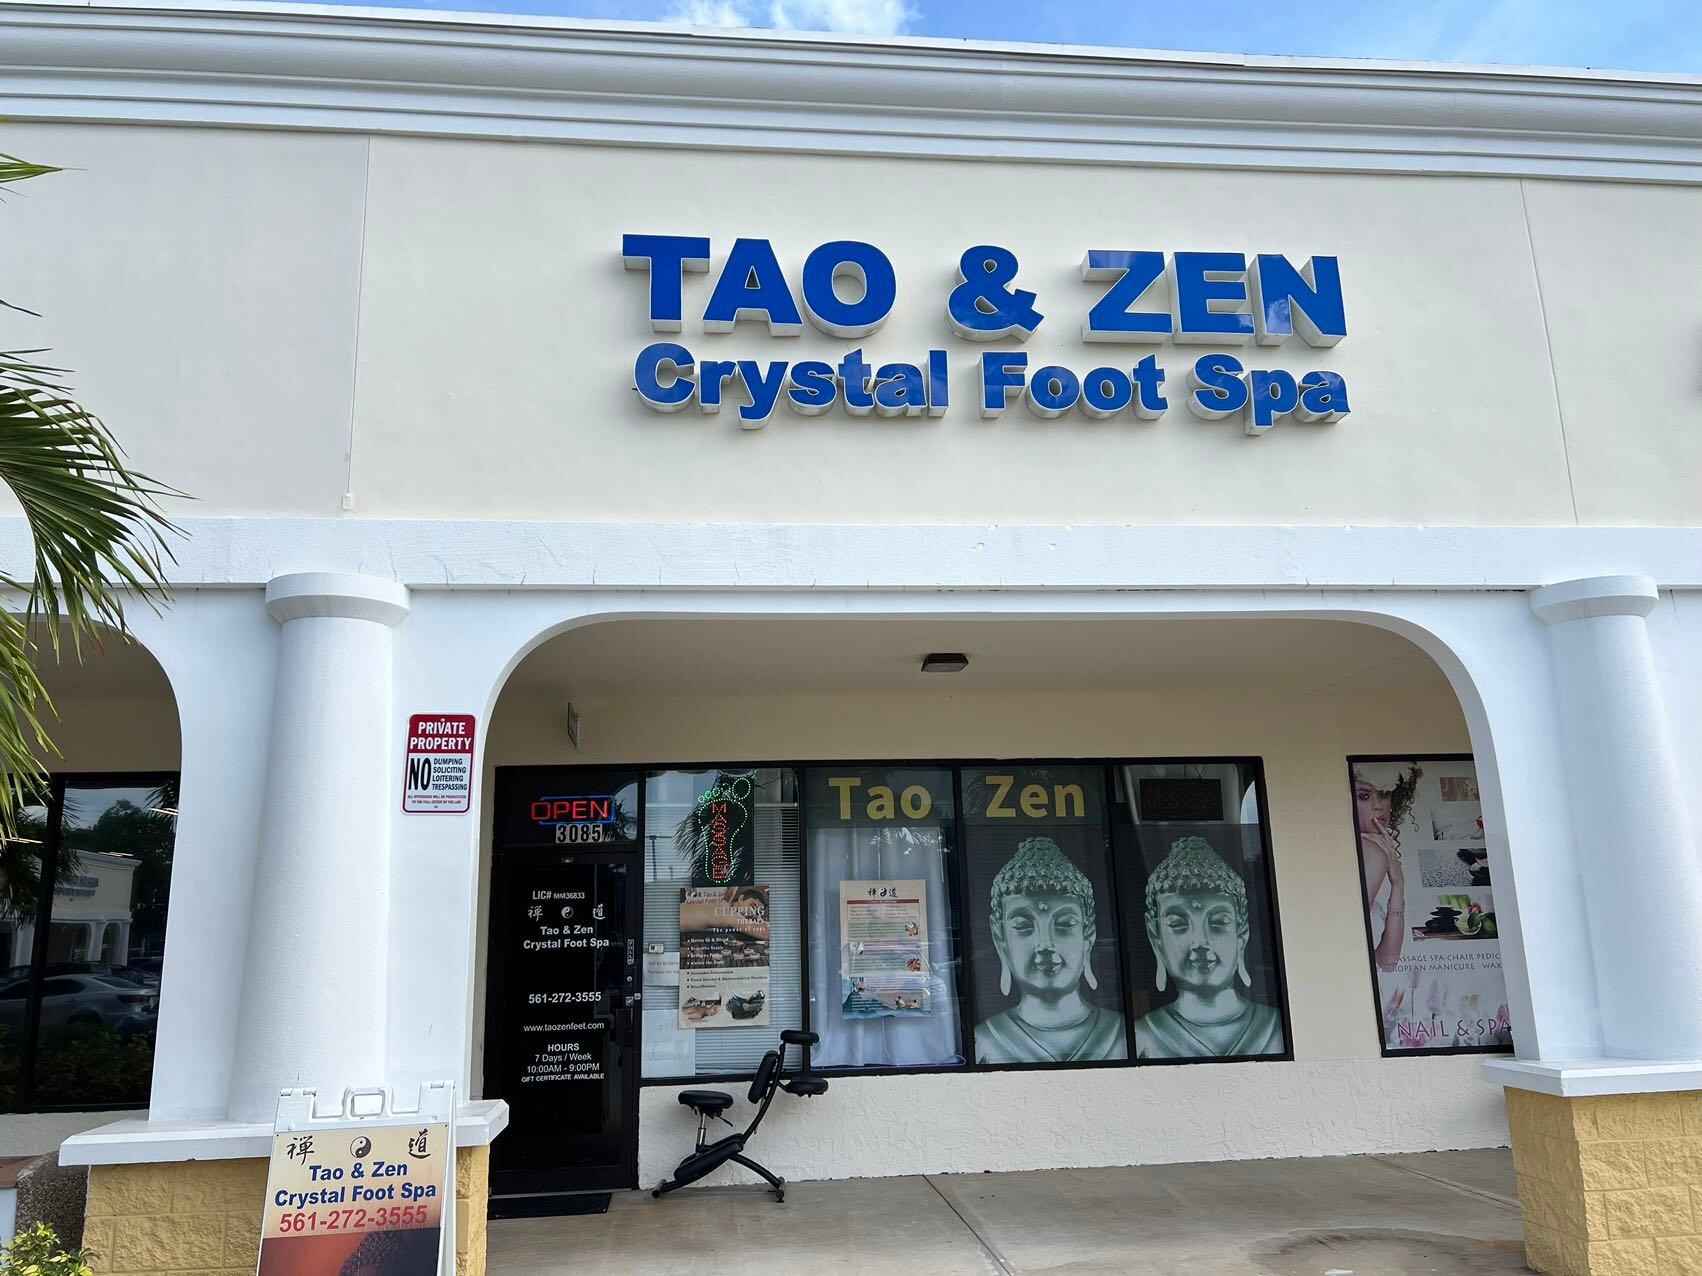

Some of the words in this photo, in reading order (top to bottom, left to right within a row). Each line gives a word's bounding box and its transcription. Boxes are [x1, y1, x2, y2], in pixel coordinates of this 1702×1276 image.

[622, 233, 897, 330] TAO
[947, 245, 1045, 334] &
[1084, 249, 1348, 338] ZEN
[633, 341, 949, 422] Crystal
[980, 351, 1169, 412] Foot
[1192, 352, 1351, 428] Spa
[418, 721, 466, 735] PRIVATE
[409, 737, 472, 750] PROPERTY
[408, 757, 432, 791] NO
[432, 766, 467, 774] SOLICITING
[431, 783, 468, 791] TRESPASSING
[828, 776, 932, 820] Tao
[985, 775, 1085, 818] Zen
[531, 800, 609, 820] OPEN
[557, 824, 601, 843] 3085
[532, 890, 552, 900] LIC#
[714, 905, 766, 917] CUPPING
[540, 926, 559, 935] Tao
[562, 925, 571, 934] &
[573, 925, 593, 934] Zen
[523, 939, 561, 951] Crystal
[564, 938, 587, 947] Foot
[590, 938, 610, 949] Spa
[1446, 953, 1474, 961] CHAIR
[1429, 963, 1475, 971] MANICURE
[528, 991, 602, 1004] 561-272-3555
[523, 1022, 605, 1032] www.taozenfeet.com
[1397, 1019, 1450, 1038] NAIL
[1457, 1019, 1470, 1037] &
[1477, 1017, 1512, 1036] SPA
[547, 1043, 579, 1052] HOURS
[535, 1054, 539, 1062] 7
[542, 1054, 562, 1063] Days
[527, 1065, 562, 1073] 10:00AM
[569, 1063, 600, 1072] 9:00PM
[309, 1164, 344, 1181] Tao
[350, 1162, 365, 1179] &
[371, 1161, 408, 1178] Zen
[275, 1186, 345, 1209] Crystal
[352, 1184, 395, 1201] Foot
[401, 1182, 436, 1201] Spa
[279, 1204, 428, 1233] 561-272-3555
